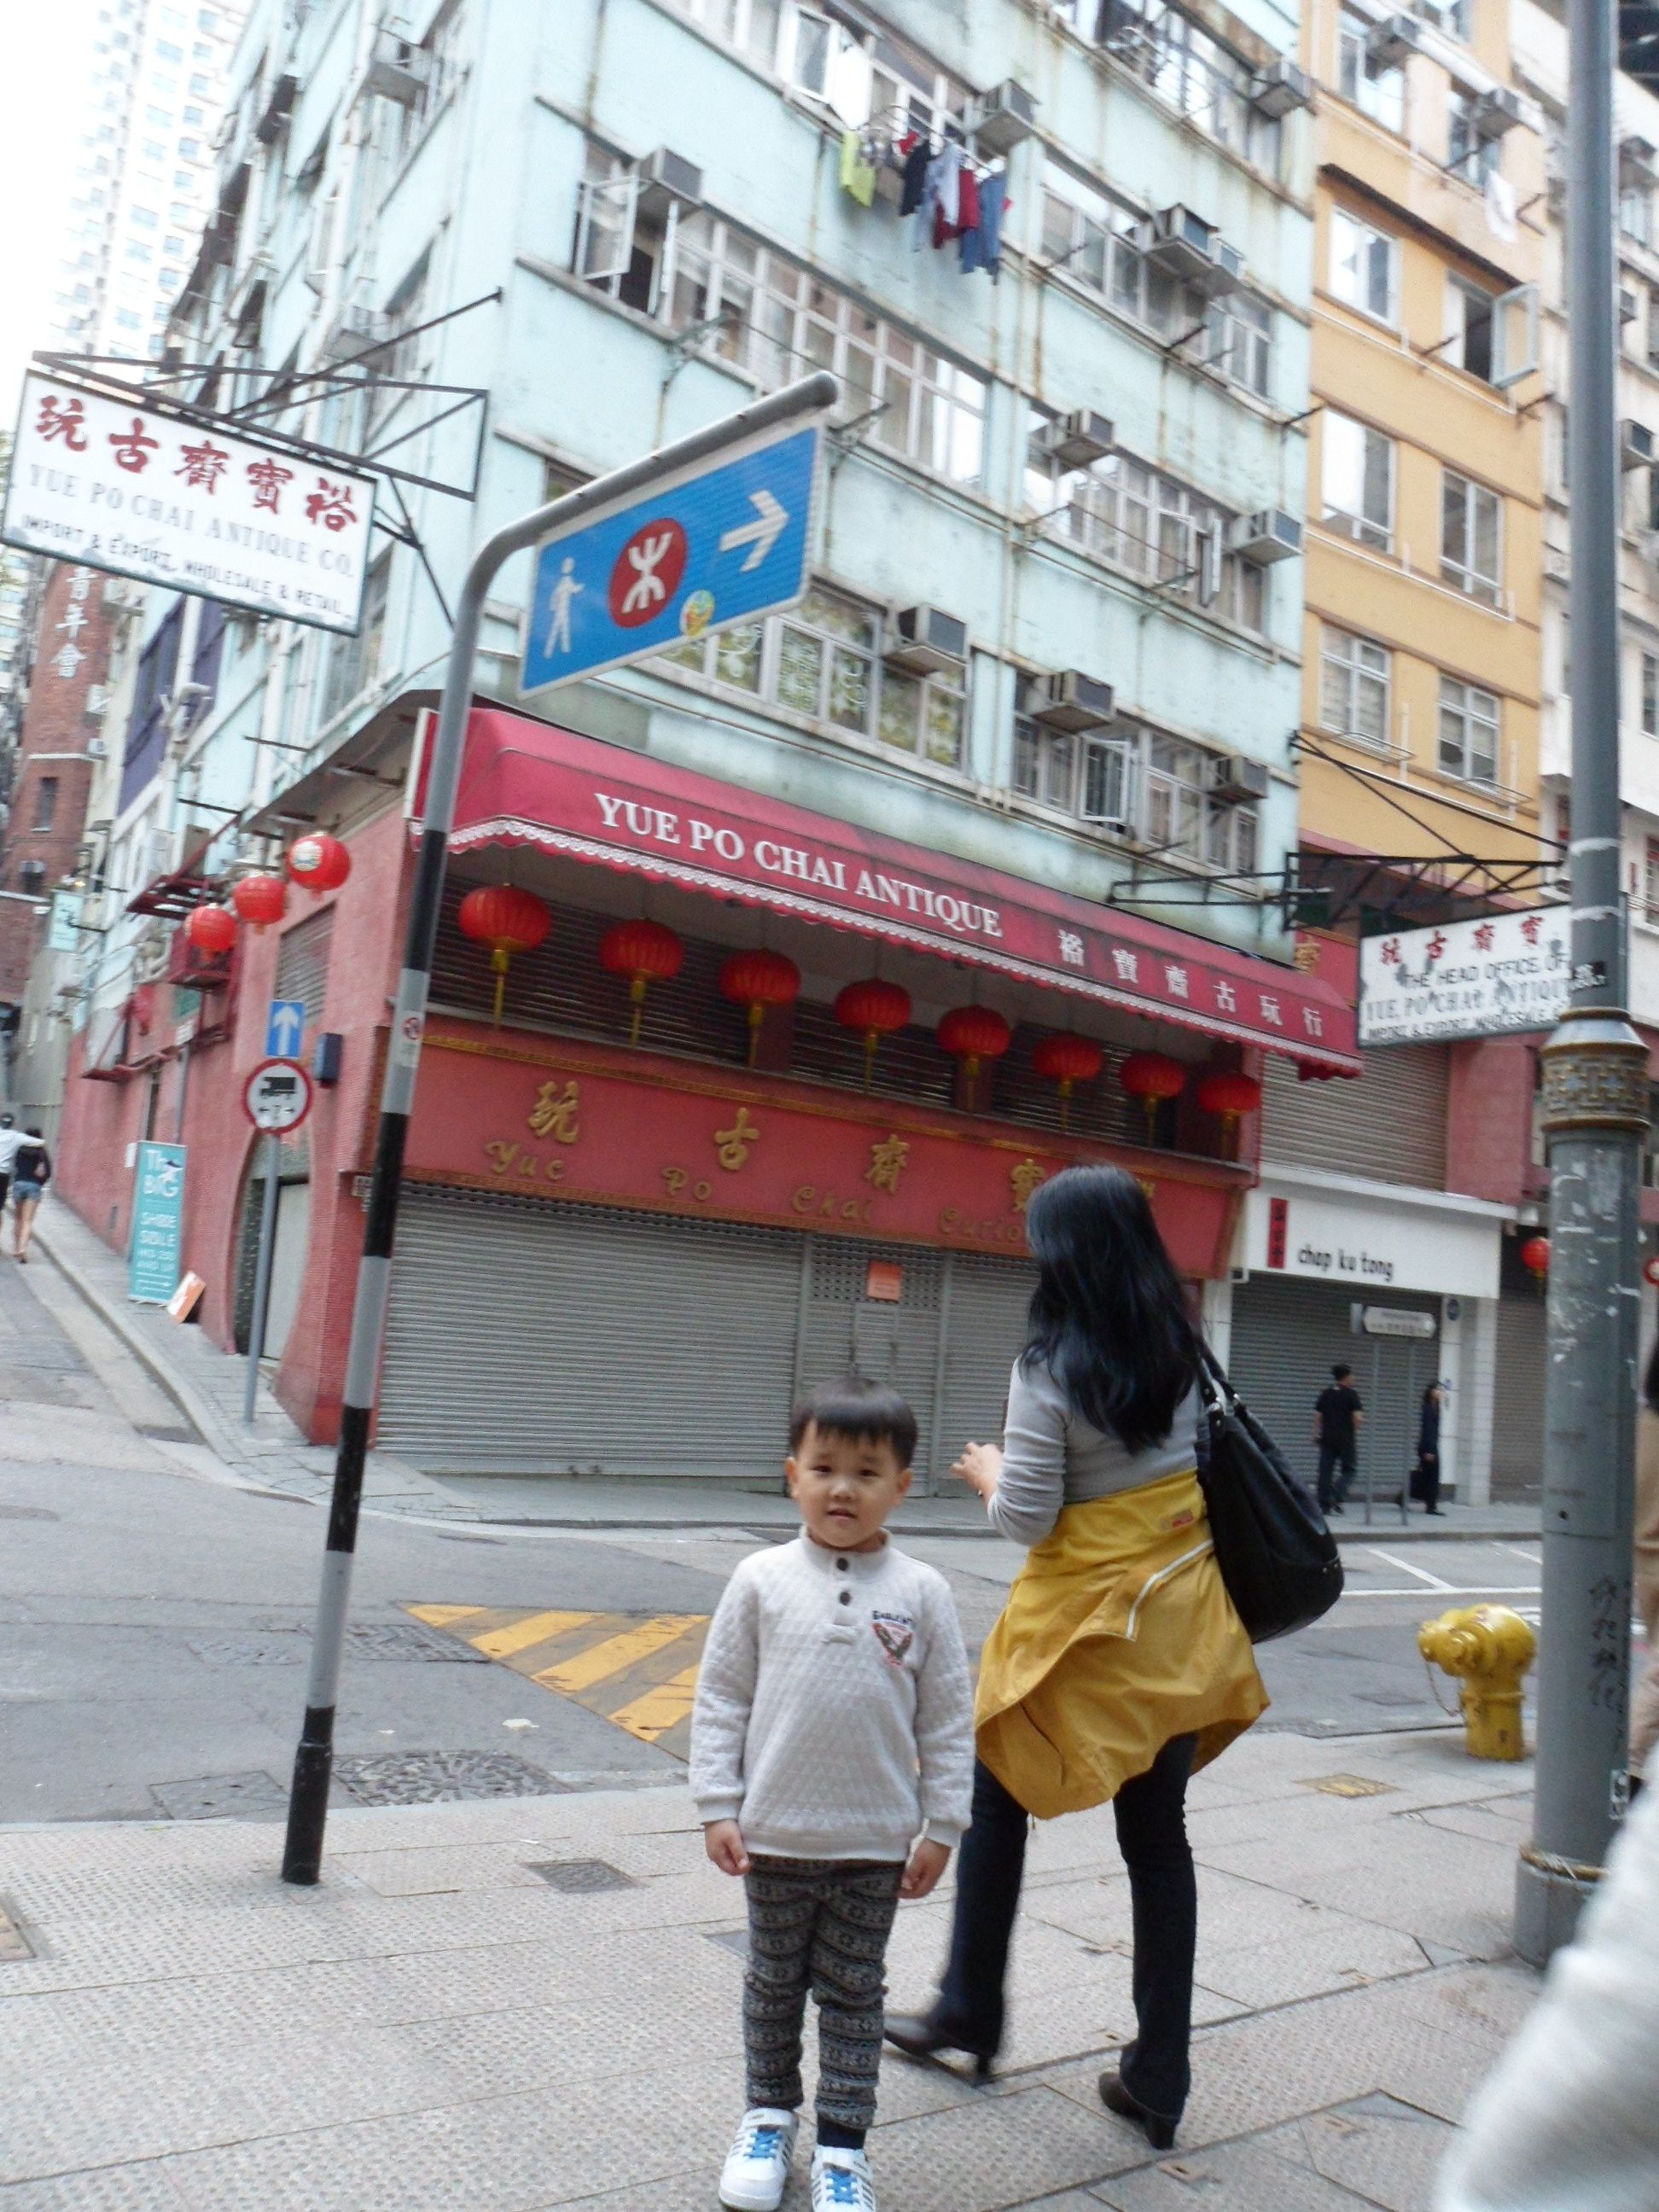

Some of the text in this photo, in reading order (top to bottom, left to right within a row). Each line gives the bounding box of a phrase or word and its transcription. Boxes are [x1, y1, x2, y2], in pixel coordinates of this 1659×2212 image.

[22, 515, 84, 544] IMPORT
[30, 464, 74, 498] YUE
[90, 481, 124, 509] PO
[131, 495, 195, 532] CHAI
[207, 517, 309, 564] ANTIQUE
[595, 793, 1003, 939] YUE PO CHAI ANTIQUE
[1361, 1252, 1394, 1283] tong
